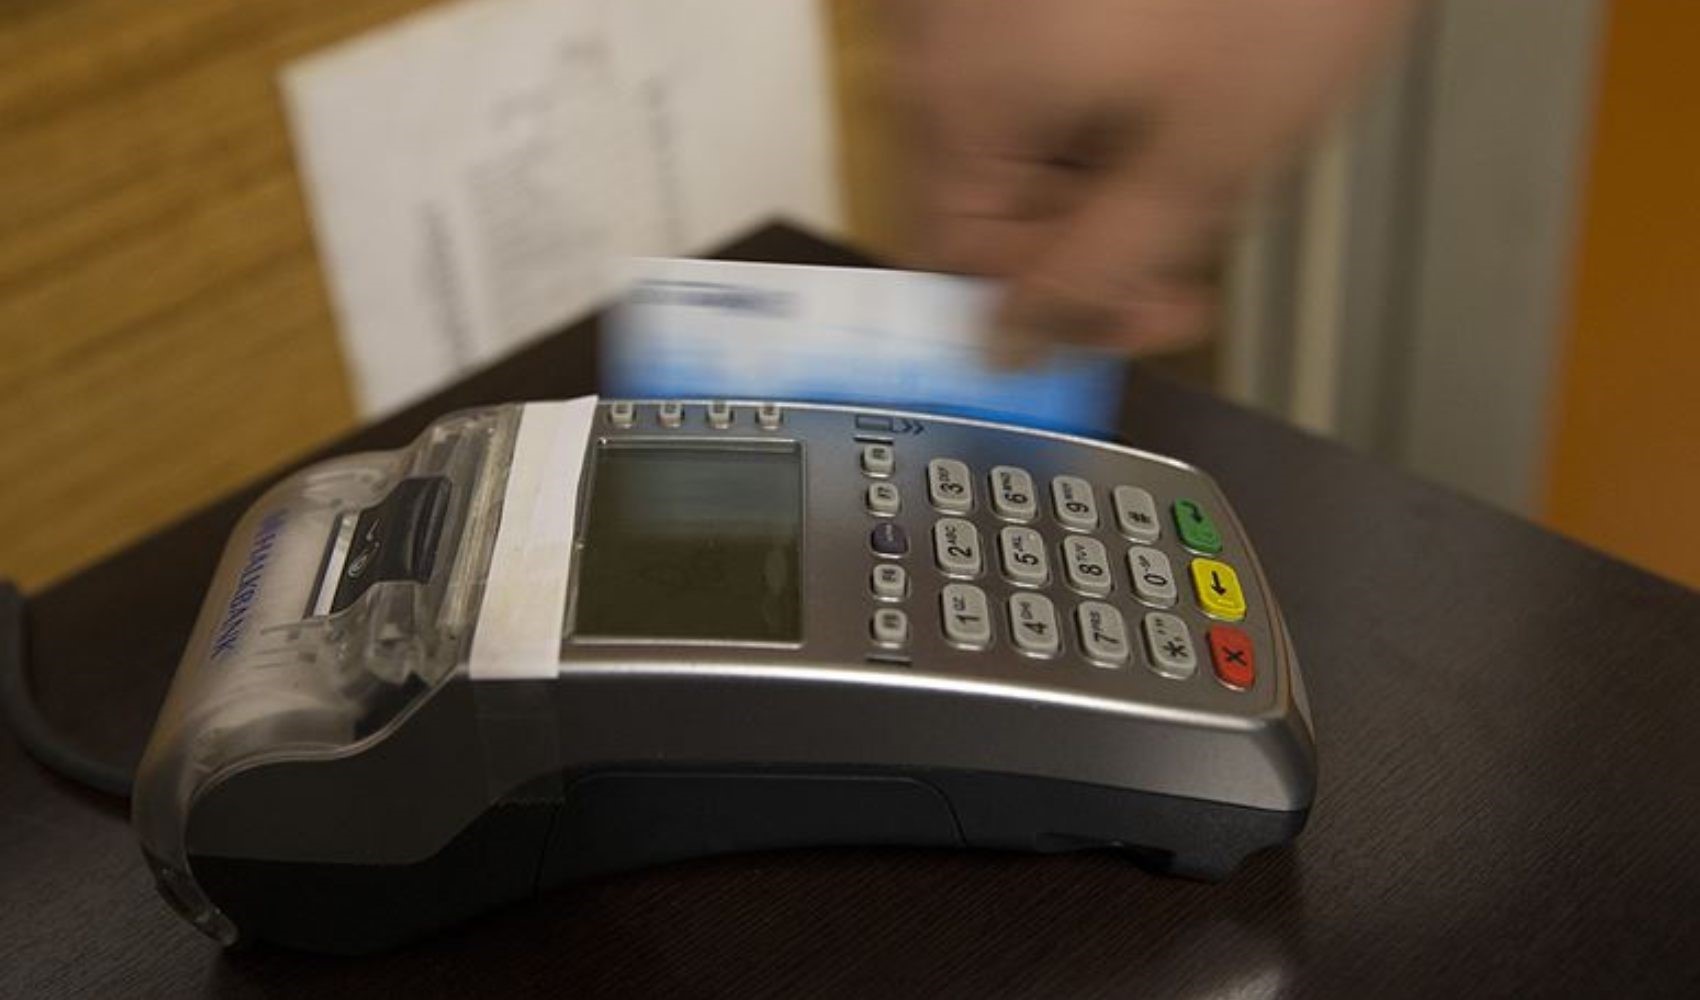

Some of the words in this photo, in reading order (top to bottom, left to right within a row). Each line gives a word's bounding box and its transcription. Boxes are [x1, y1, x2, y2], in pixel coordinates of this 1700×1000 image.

[940, 483, 964, 495] 3
[1005, 493, 1028, 504] 6
[1066, 502, 1089, 513] 9
[948, 547, 971, 558] 2
[1015, 553, 1038, 565] 5
[1079, 564, 1103, 576] 8
[956, 615, 980, 624] 1
[1024, 622, 1046, 635] 4
[1095, 631, 1119, 644] 7
